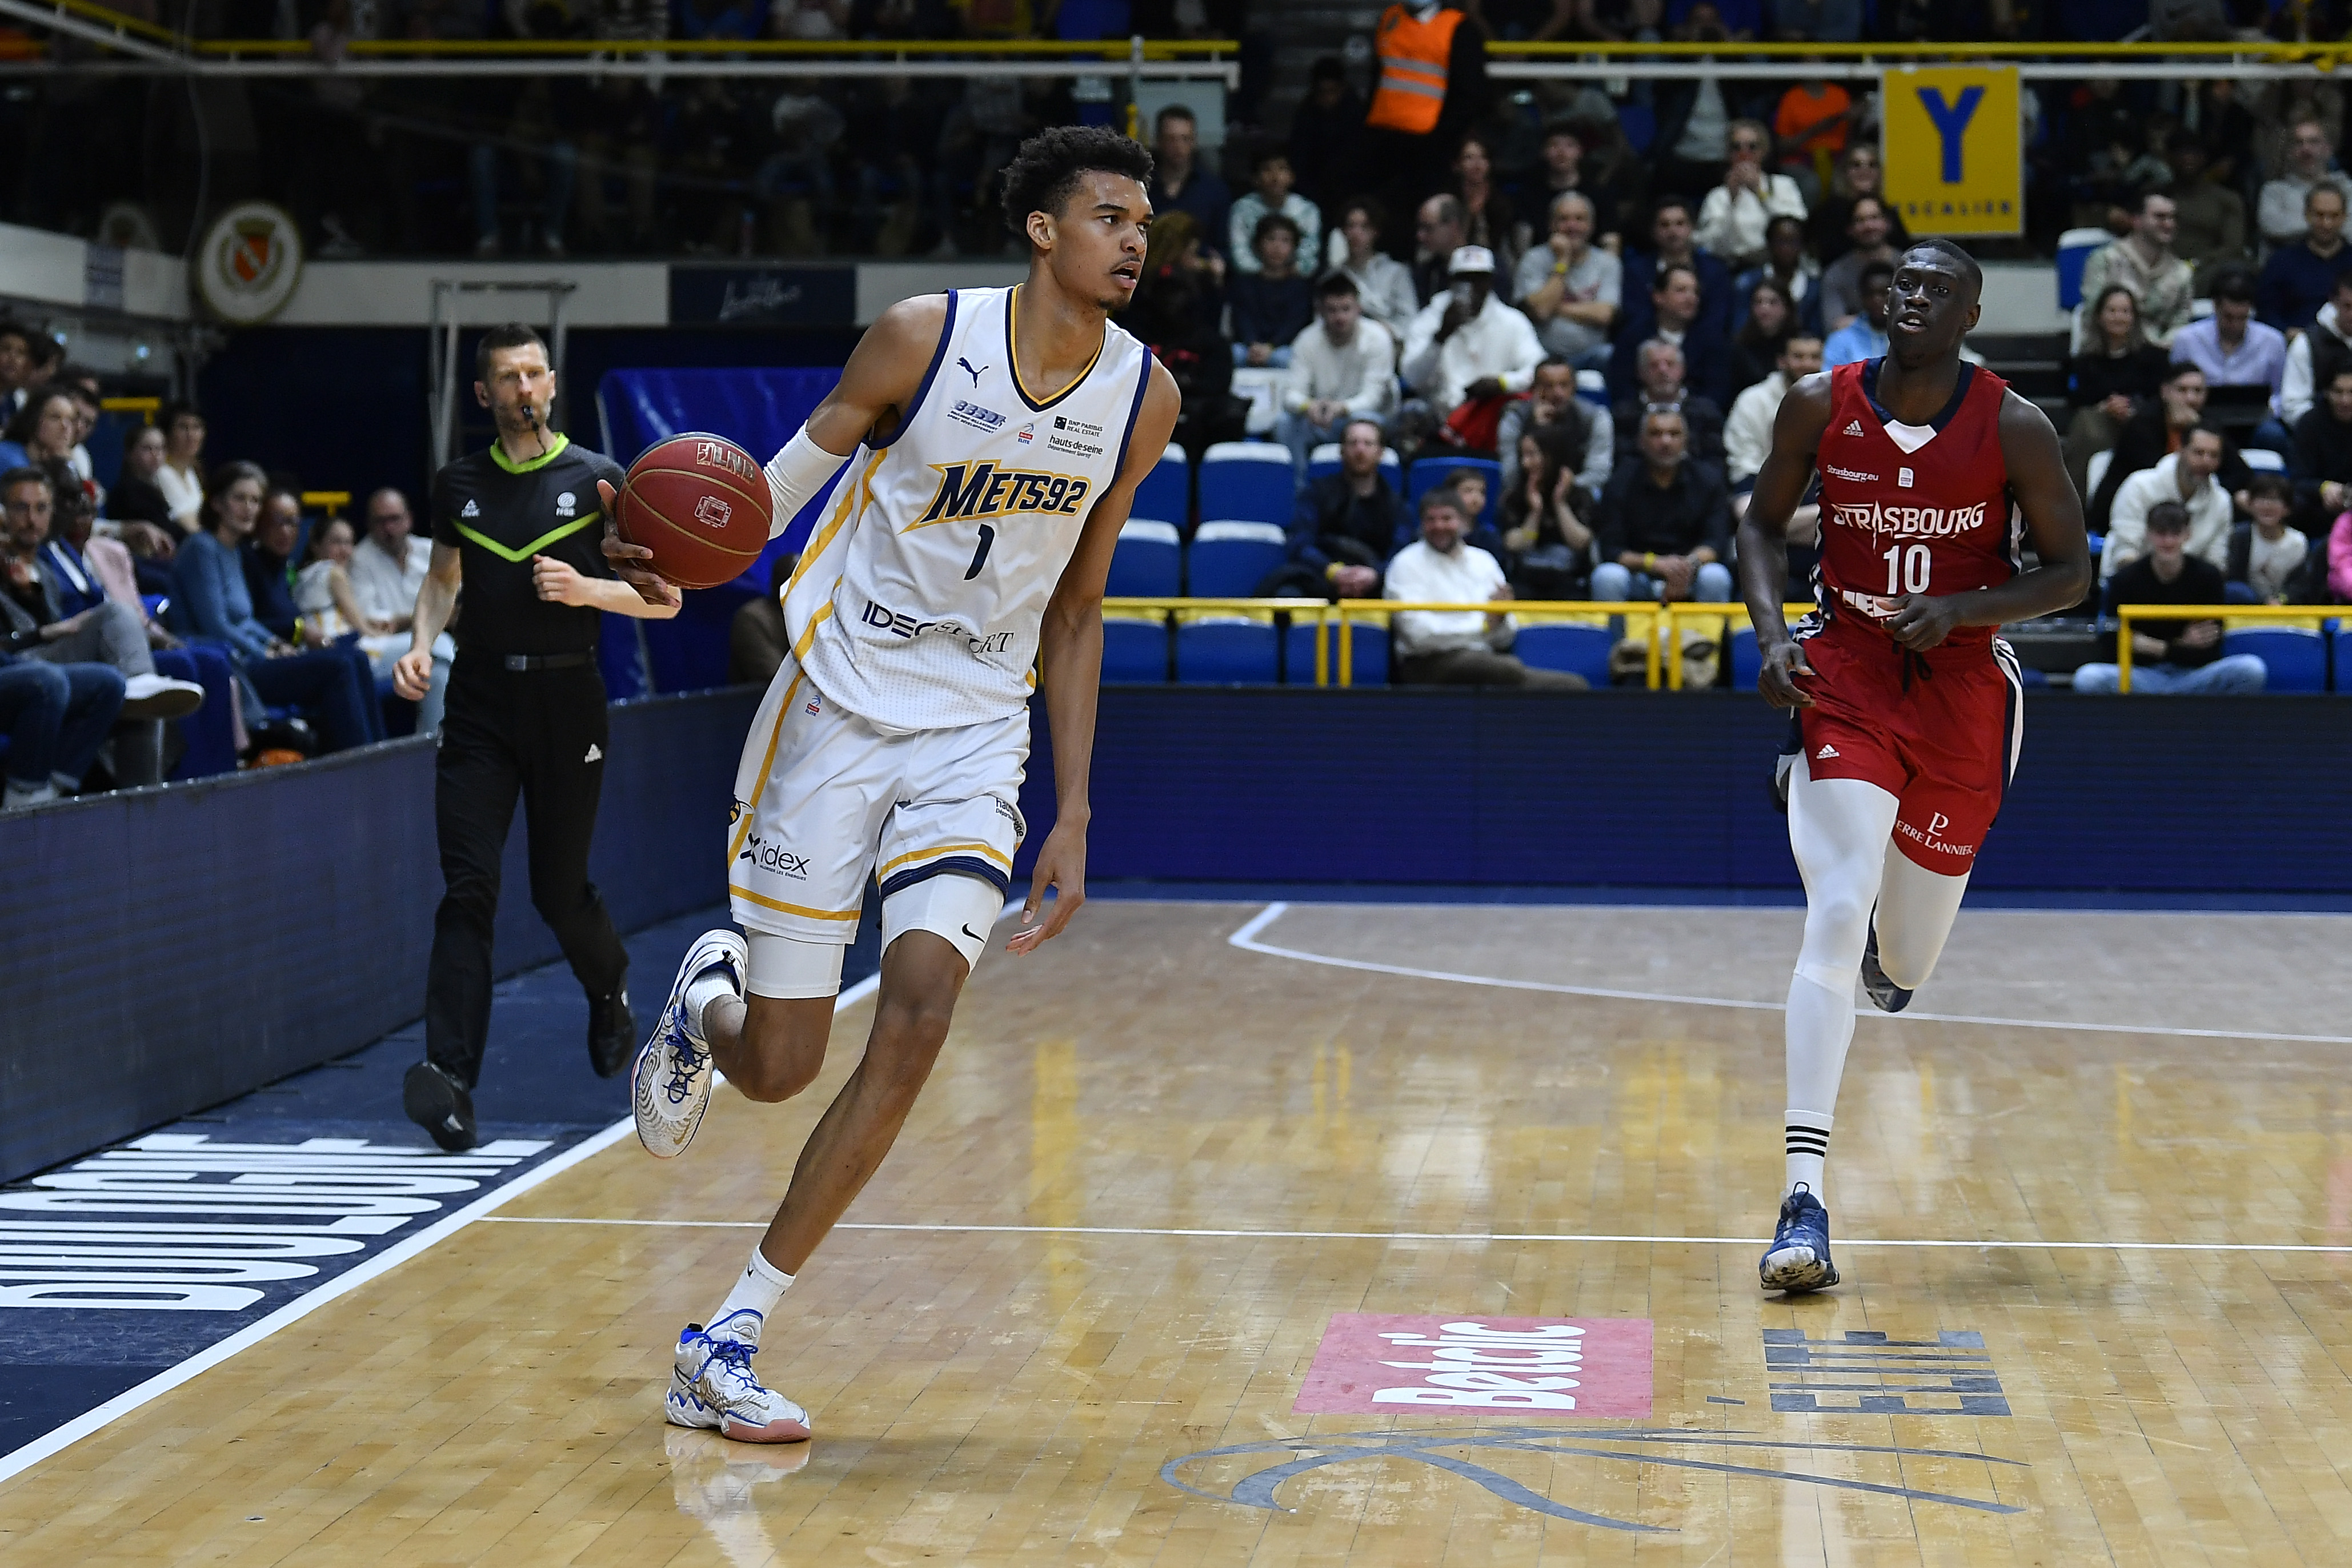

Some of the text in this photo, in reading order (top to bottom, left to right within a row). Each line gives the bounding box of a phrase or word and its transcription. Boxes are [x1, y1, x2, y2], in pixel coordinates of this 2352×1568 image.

[1917, 85, 1986, 184] Y
[1080, 423, 1103, 432] PARIBAS
[1081, 429, 1100, 438] ESTATE
[714, 445, 755, 481] LNB
[1826, 464, 1879, 482] Strasbourg.eu
[1831, 500, 1987, 539] STRASBOURG
[964, 523, 995, 581] 1
[1883, 544, 1932, 595] 10
[1896, 820, 1925, 843] ERRE
[760, 840, 811, 876] idex
[1371, 1321, 1586, 1410] Betclic
